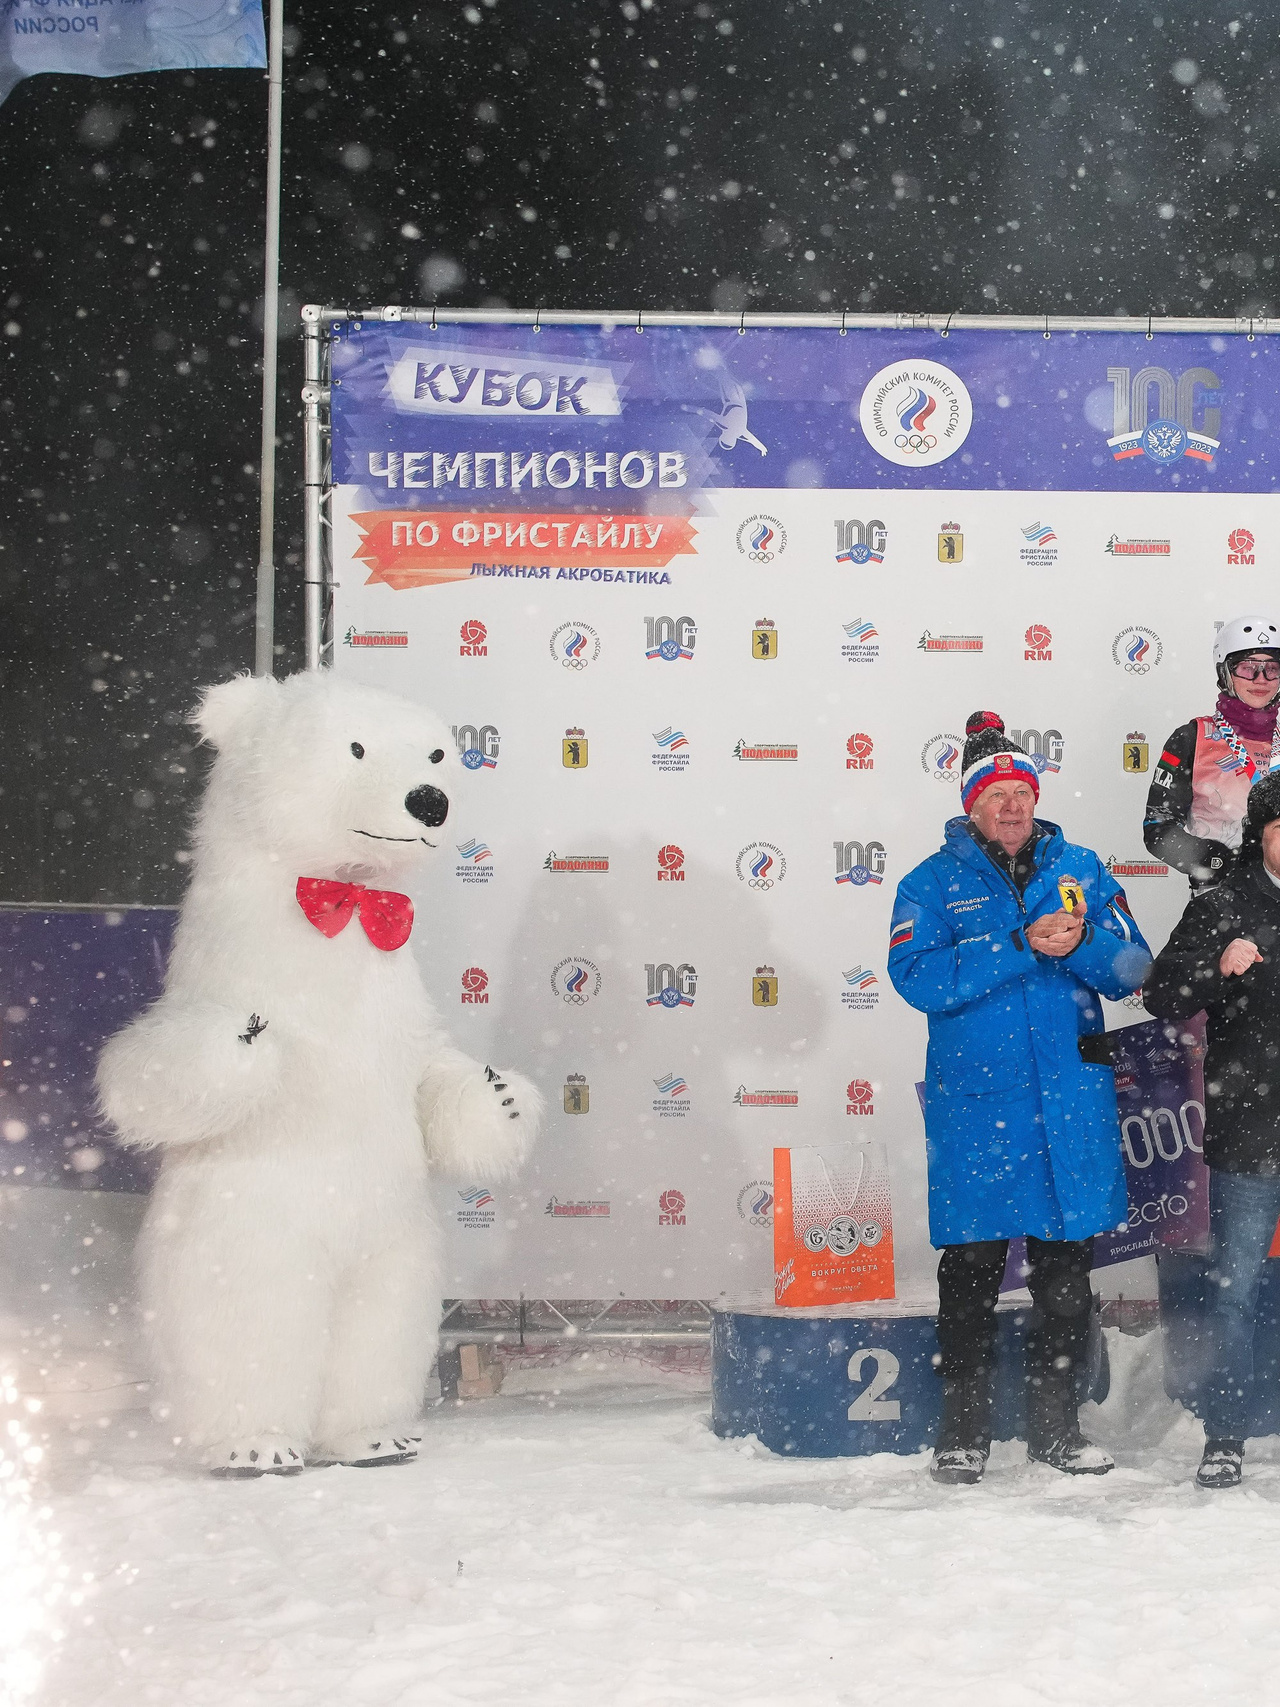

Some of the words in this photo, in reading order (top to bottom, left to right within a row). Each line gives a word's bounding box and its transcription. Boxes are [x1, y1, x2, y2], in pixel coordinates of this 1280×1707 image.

[414, 362, 591, 415] КУБОК
[873, 371, 910, 438] ОЛИМПИЙСКИЙ
[913, 371, 954, 400] КОМИТЕТ
[944, 398, 960, 439] РОССИИ
[1107, 366, 1221, 440] 100
[1118, 440, 1139, 452] 1923
[1189, 441, 1212, 453] 2023
[368, 451, 690, 489] ЧЕМПИОНОВ
[391, 520, 440, 548] ПО
[451, 515, 664, 550] ФРИСТАЙЛУ
[1228, 554, 1255, 565] RM
[469, 562, 551, 580] ЛЫЖНАЯ
[555, 566, 672, 585] АКРОБАТИКА
[460, 646, 488, 656] RM
[1024, 650, 1052, 661] RM
[944, 733, 968, 745] КОМИТ
[846, 759, 874, 769] RM
[658, 871, 685, 881] RM
[954, 904, 982, 914] ОБЛАСТЬ
[462, 993, 489, 1004] RM
[847, 1105, 874, 1115] RM
[660, 1215, 686, 1225] RM
[1110, 1237, 1160, 1256] ЯРОСЛАВЛЬ
[811, 1267, 847, 1277] ВОКРУГ
[851, 1264, 879, 1273] СВЕТА
[847, 1348, 902, 1421] 2
